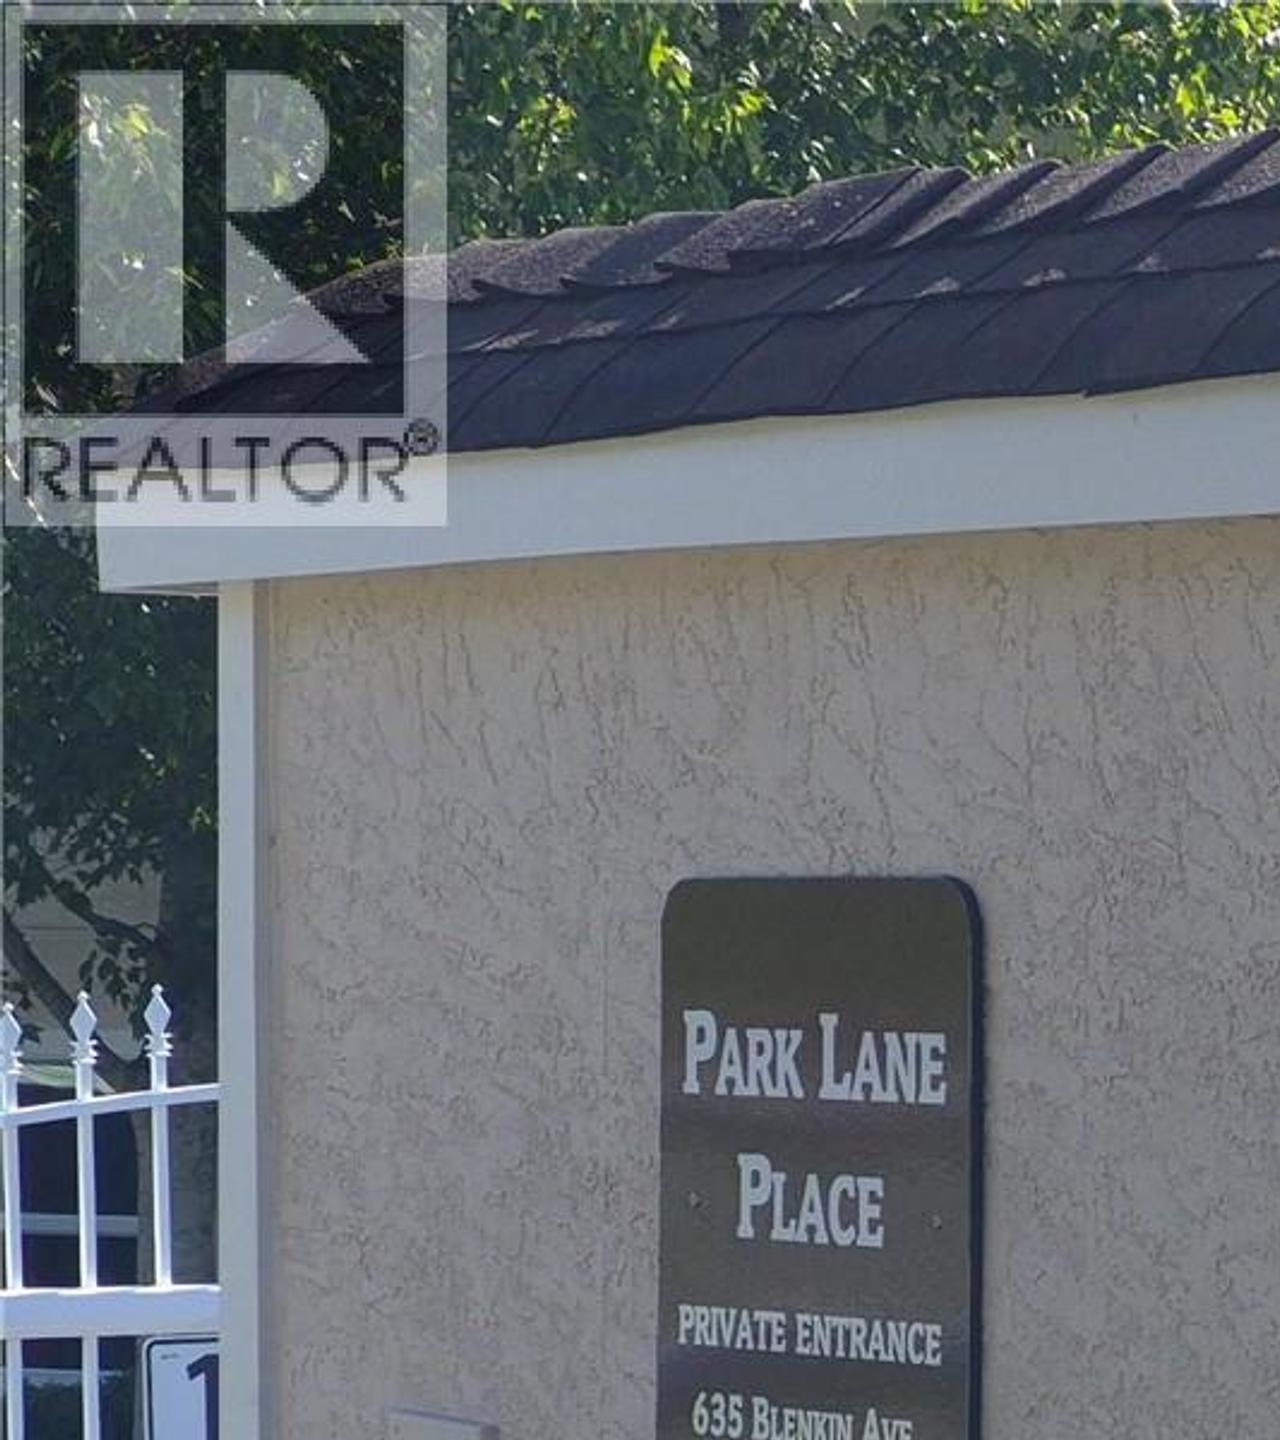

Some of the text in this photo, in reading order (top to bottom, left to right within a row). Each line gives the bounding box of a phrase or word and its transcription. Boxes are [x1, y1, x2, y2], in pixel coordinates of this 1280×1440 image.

[682, 1009, 947, 1105] PARK LANE
[736, 1153, 885, 1248] PLACE
[678, 1304, 943, 1367] PRIVATE ENTRANCE
[692, 1391, 744, 1440] 635
